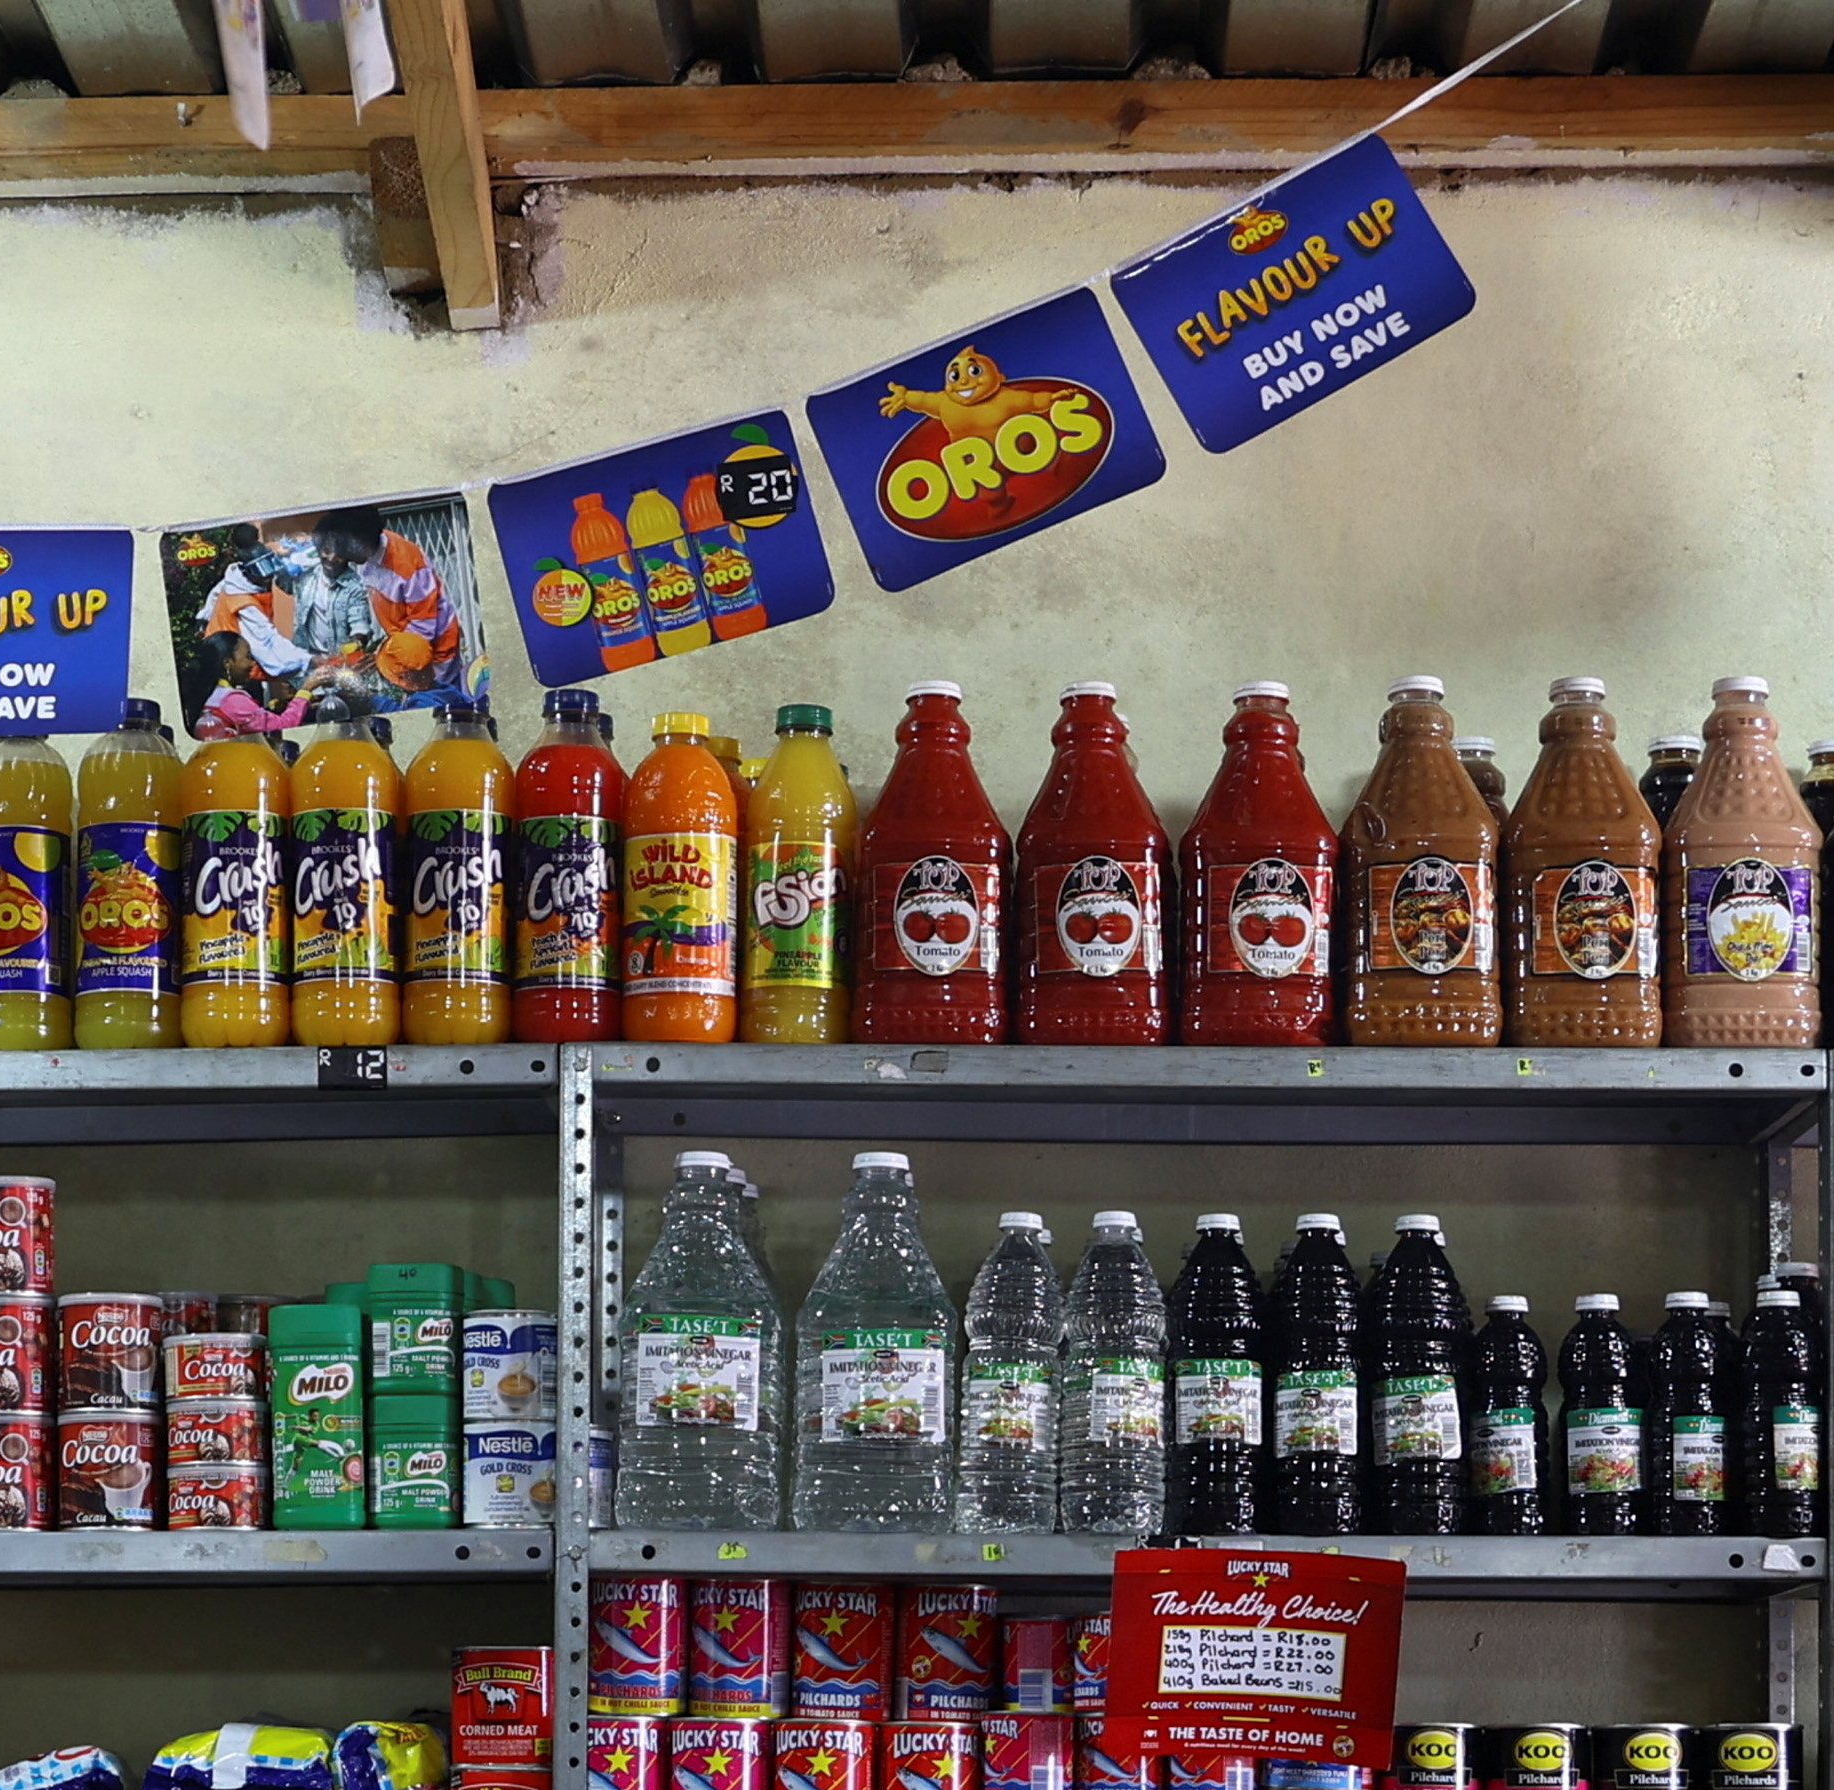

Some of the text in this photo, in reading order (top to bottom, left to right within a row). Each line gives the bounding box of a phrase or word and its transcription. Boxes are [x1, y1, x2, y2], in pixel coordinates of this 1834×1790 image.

[1228, 212, 1287, 253] OROS
[1176, 198, 1397, 359] FLAVOUR UP
[1242, 284, 1392, 381] BUY NOW
[1258, 312, 1412, 410] AND SAVE
[749, 469, 793, 504] 20
[537, 583, 587, 603] NEW
[58, 588, 108, 631] UP
[414, 845, 502, 915] Crush
[1073, 862, 1118, 892] TOP
[1077, 945, 1124, 959] Tomato
[356, 1050, 384, 1081] 12
[670, 1316, 730, 1335] TASE'T
[71, 1322, 151, 1350] Cocoa
[296, 1372, 349, 1395] MILO
[479, 1438, 534, 1455] Nestlé
[480, 1461, 533, 1475] GOLD CROSS
[1227, 1561, 1289, 1578] LUCKY STAR
[1152, 1591, 1369, 1628] The Healthy Choice!
[1200, 1630, 1253, 1642] Pilchard
[1199, 1644, 1335, 1660] Pilchard R22.00
[466, 1665, 534, 1682] Bull Brand
[1164, 1658, 1255, 1673] 400g Pilchard
[1163, 1675, 1283, 1689] 410g Baked Beans
[1150, 1701, 1357, 1720] QUICK CONVENIENT TASTY VERSATILE
[459, 1724, 538, 1737] CORNED MEAT
[1169, 1727, 1324, 1747] THE TASTE OF HOME
[775, 1725, 864, 1757] LUCKY STAR
[1724, 1744, 1773, 1760] KOO
[1724, 1774, 1777, 1787] Pilchards
